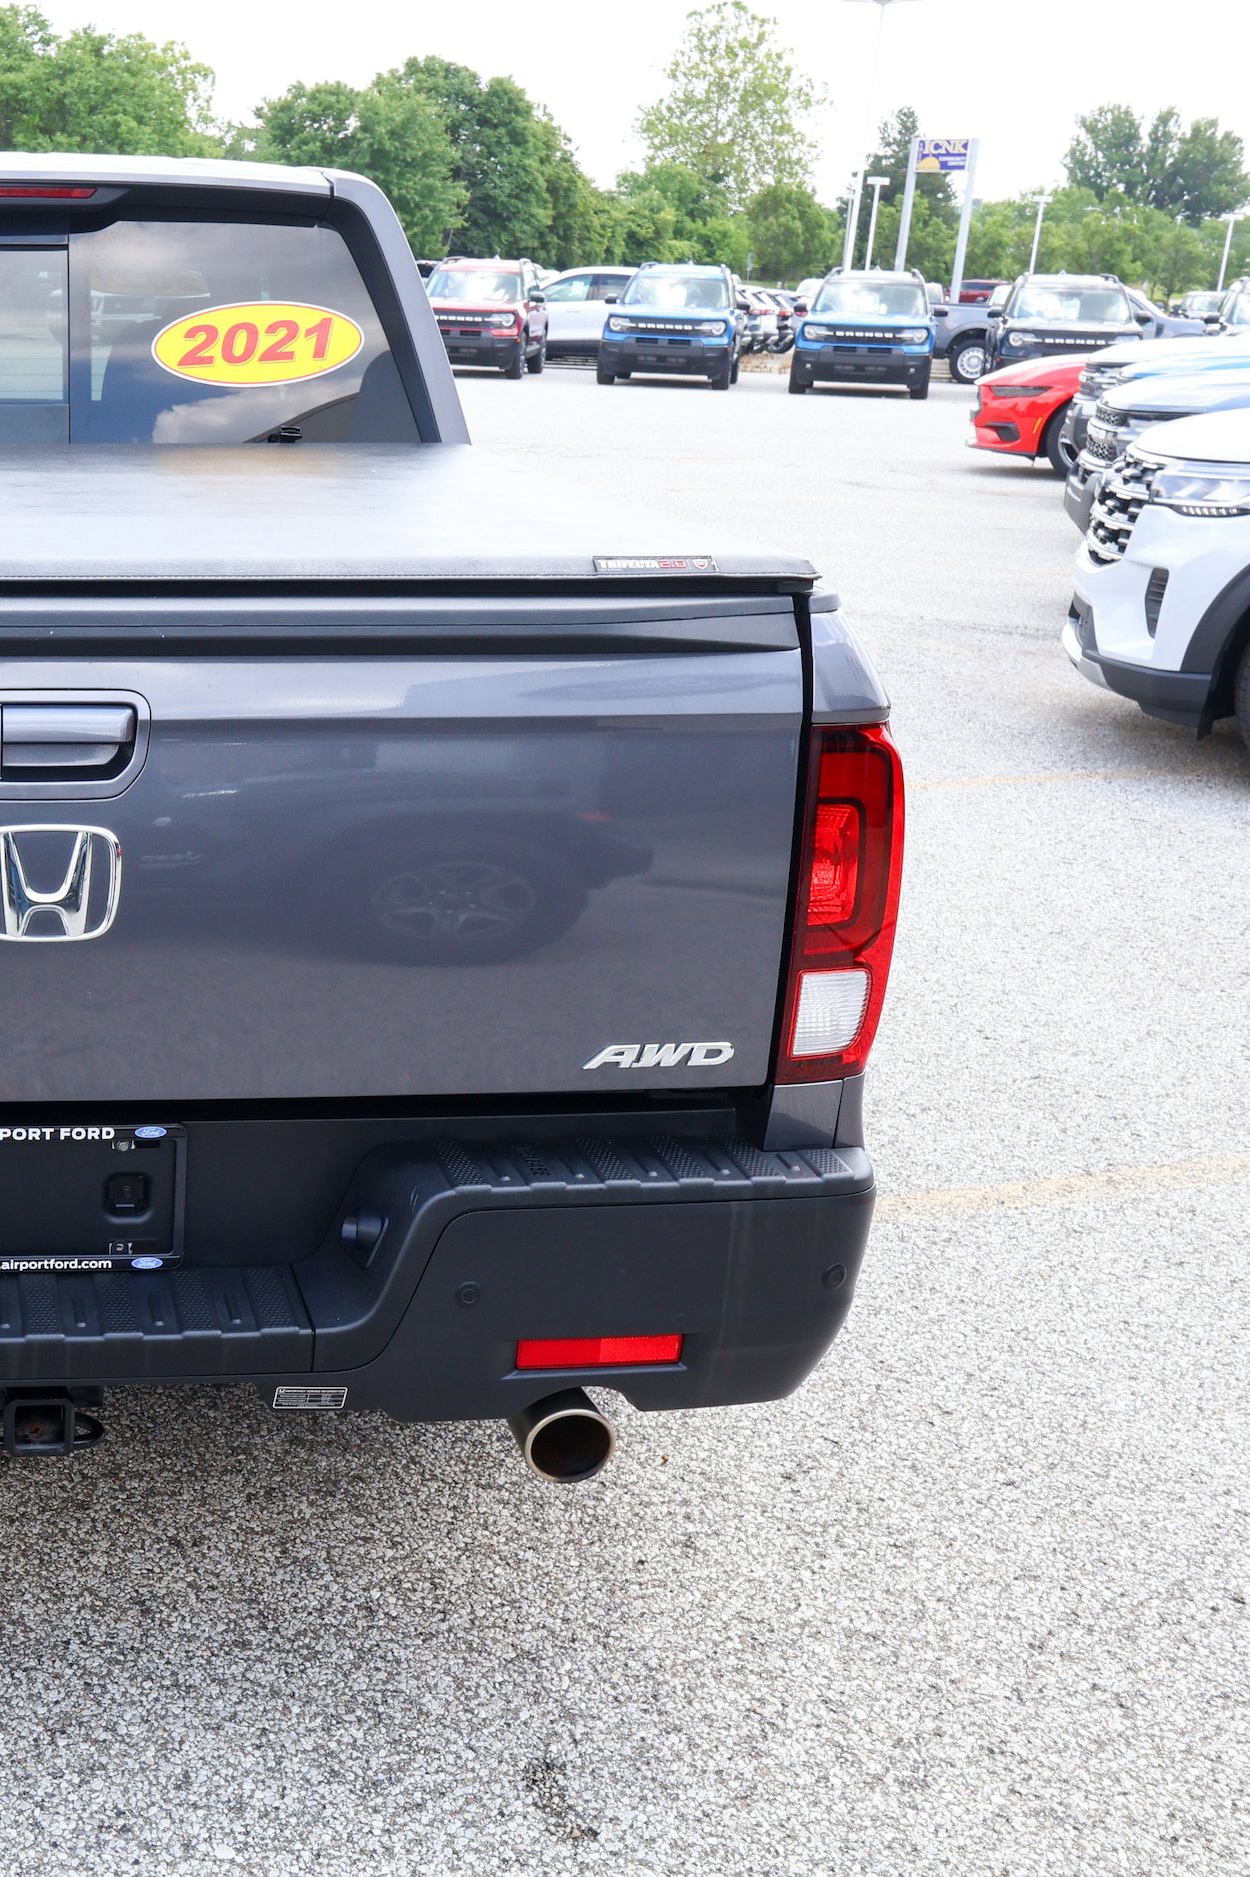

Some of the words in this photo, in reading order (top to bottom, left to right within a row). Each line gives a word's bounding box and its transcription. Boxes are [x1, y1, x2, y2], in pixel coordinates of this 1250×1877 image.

[176, 317, 334, 369] 2021
[581, 1041, 735, 1070] AWD
[59, 1127, 115, 1141] FORD
